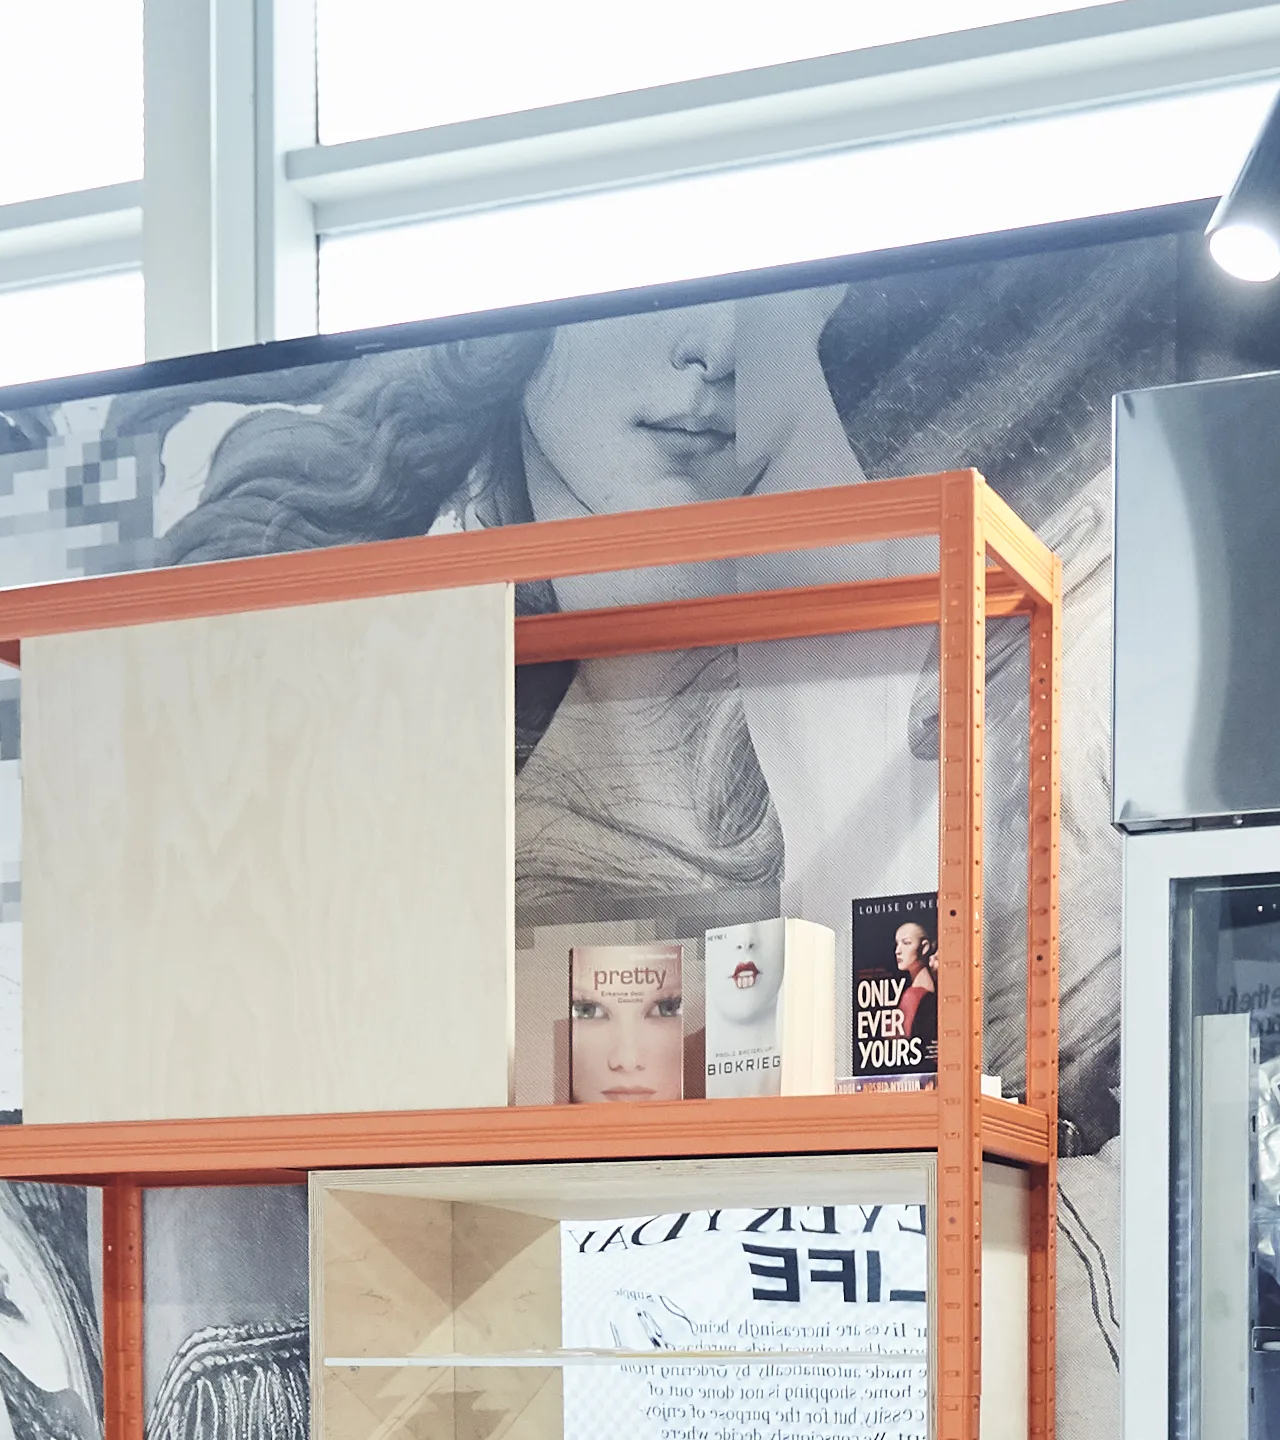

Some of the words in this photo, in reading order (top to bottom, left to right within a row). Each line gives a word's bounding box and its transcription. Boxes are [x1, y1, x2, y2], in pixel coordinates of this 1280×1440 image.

[859, 901, 900, 915] LOUISE
[906, 899, 936, 911] O'NE
[594, 966, 667, 990] pretty
[857, 977, 906, 1009] ONLY
[857, 1008, 905, 1039] EVER
[708, 1056, 780, 1076] BIOKRIEG
[858, 1037, 923, 1069] YOURS
